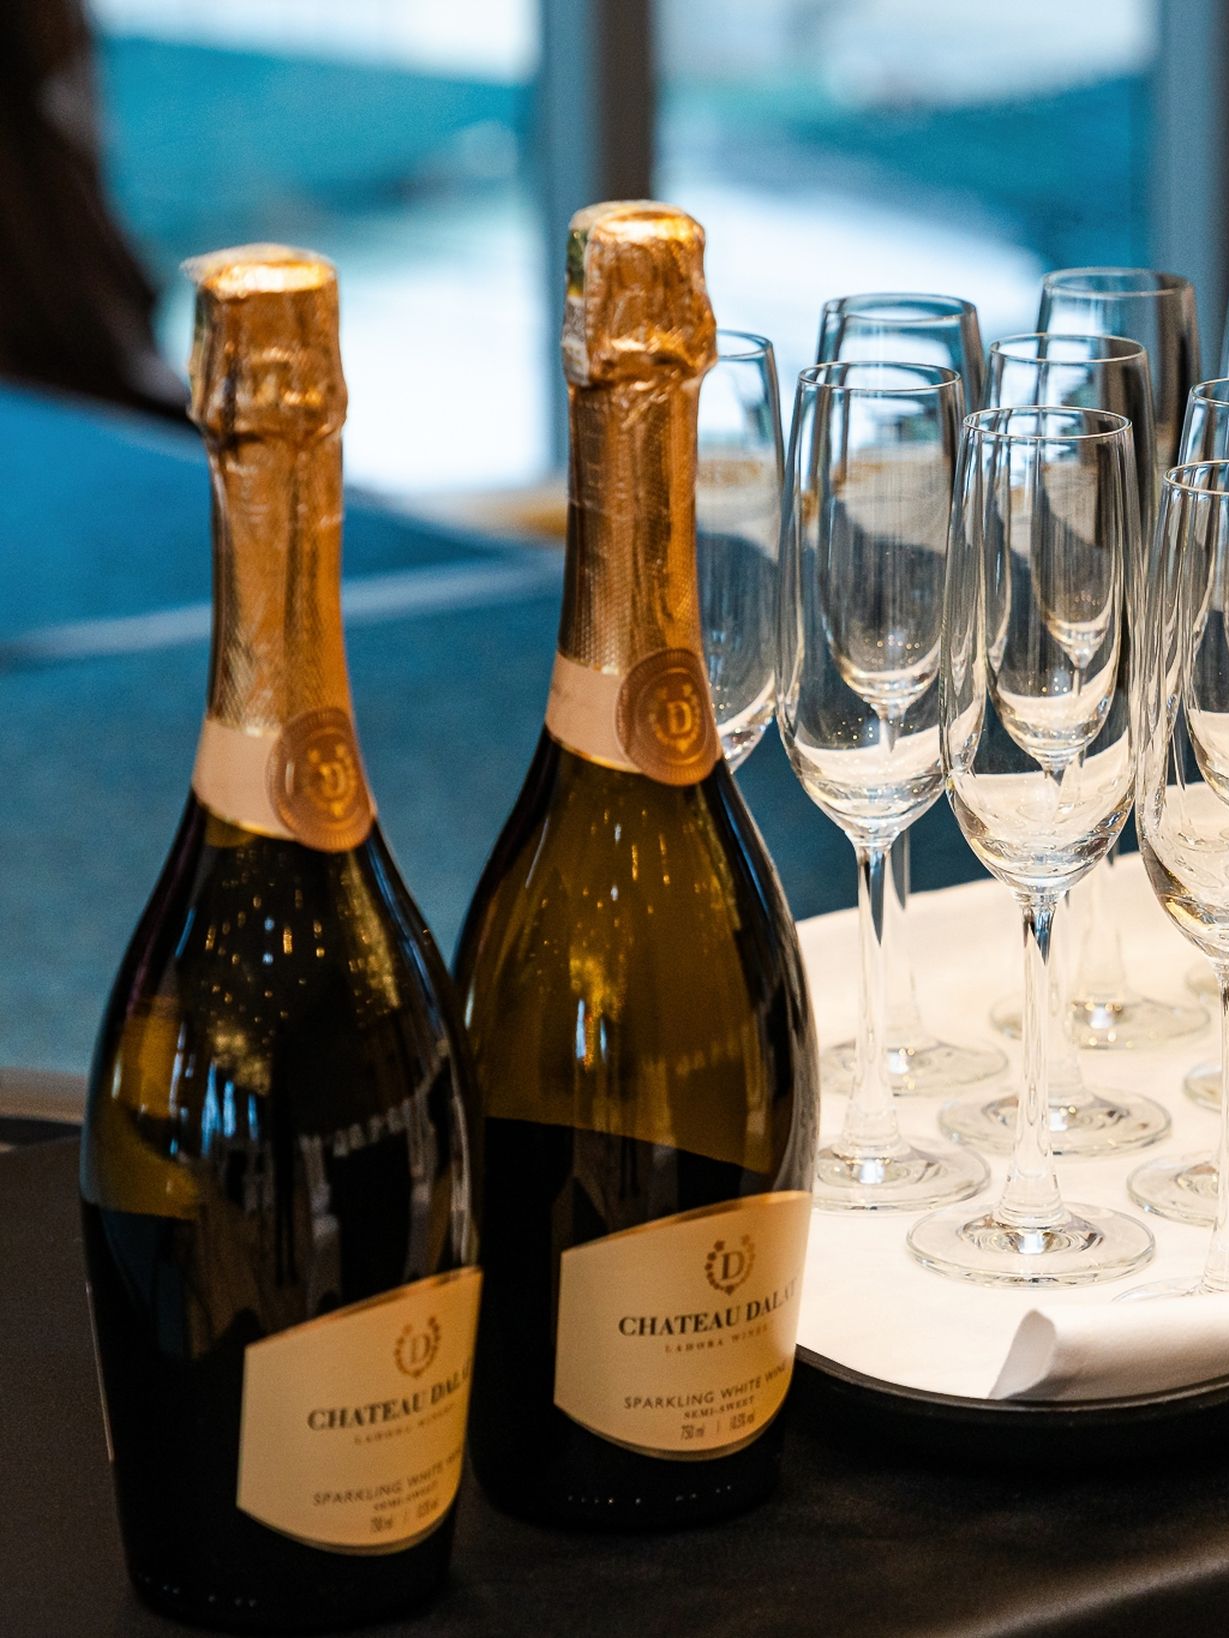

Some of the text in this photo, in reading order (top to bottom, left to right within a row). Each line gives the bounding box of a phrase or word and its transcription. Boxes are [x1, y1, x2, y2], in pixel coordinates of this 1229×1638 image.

[669, 701, 692, 734] D
[722, 1250, 745, 1280] D
[618, 1305, 741, 1337] CHATEAU
[624, 1390, 714, 1410] SPARKLING
[720, 1376, 761, 1399] WHITE
[307, 1390, 428, 1431] CHATEAU
[313, 1479, 402, 1507] SPARKLING
